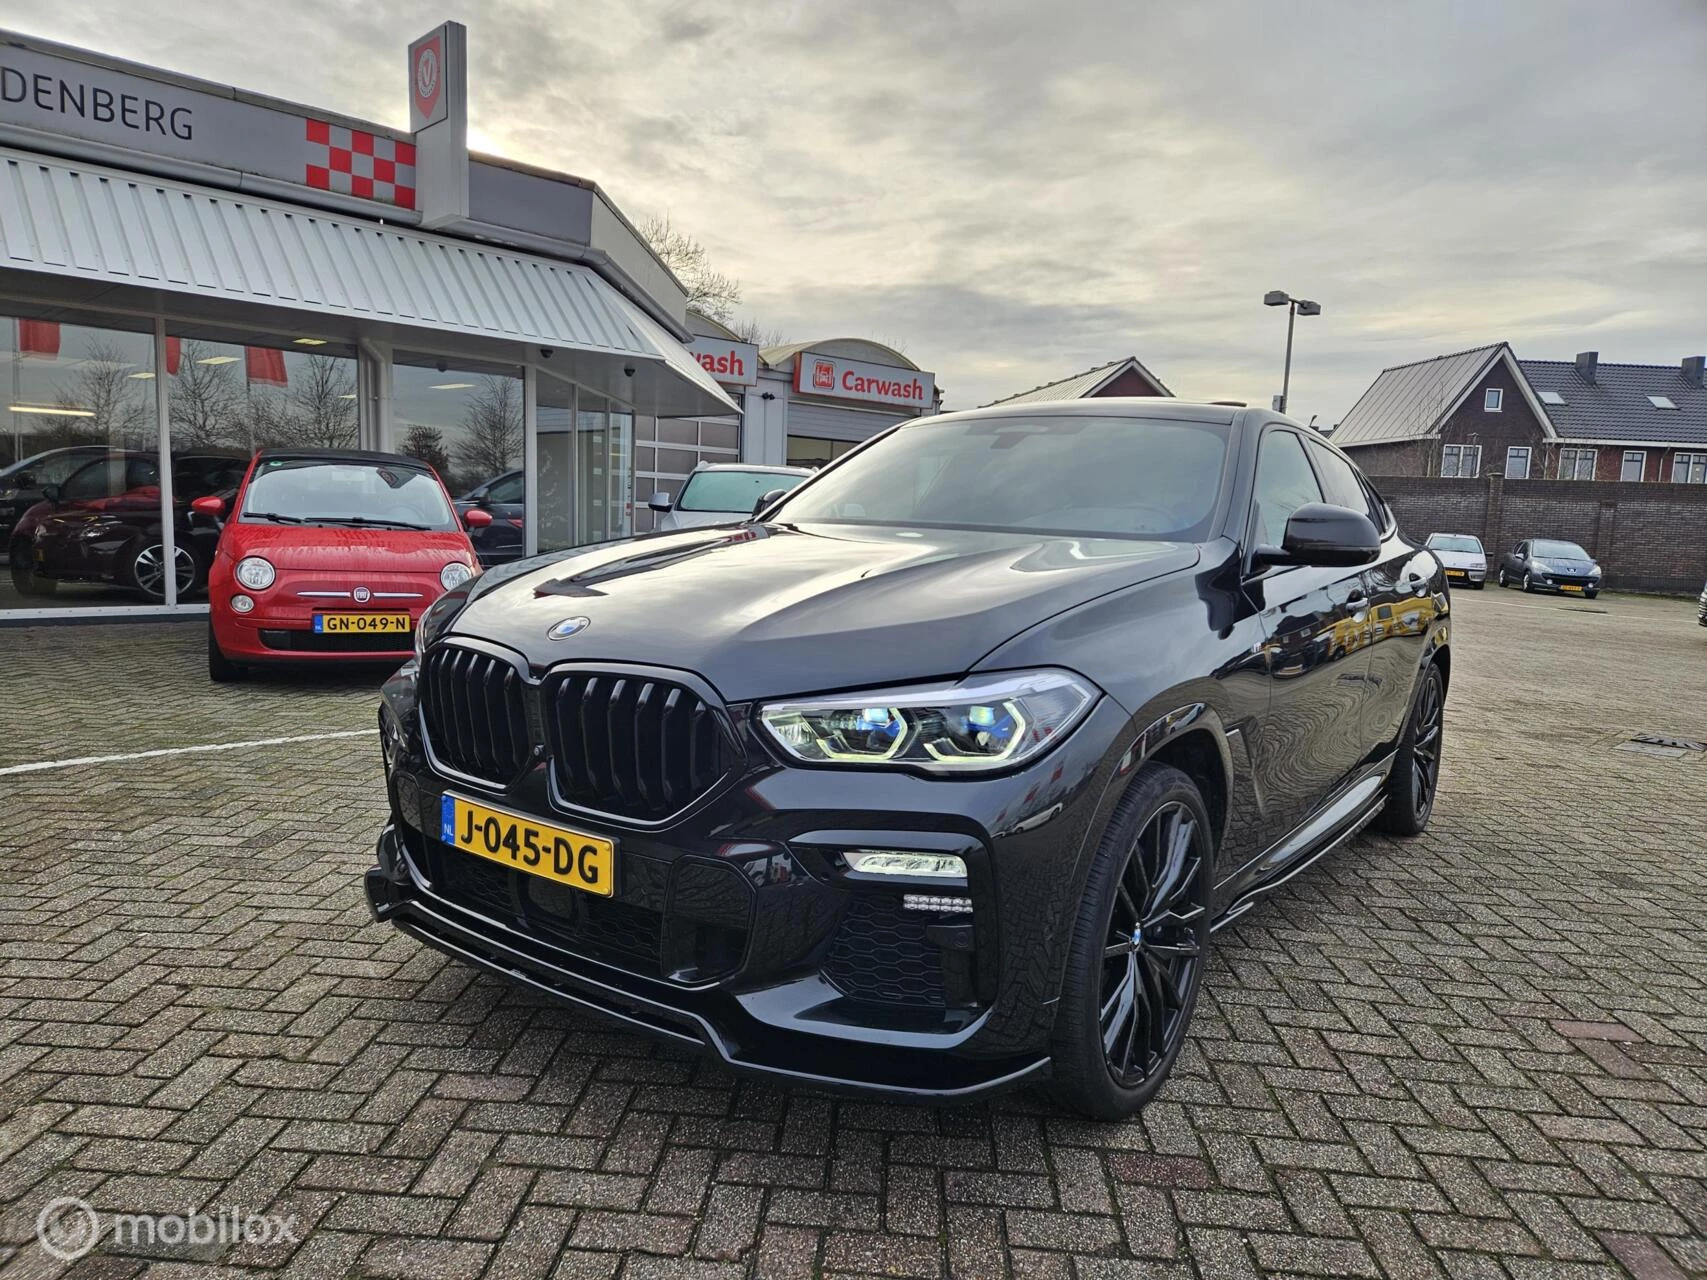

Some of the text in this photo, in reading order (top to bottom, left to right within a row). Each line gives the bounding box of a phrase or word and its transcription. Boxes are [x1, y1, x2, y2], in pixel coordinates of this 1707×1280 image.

[0, 66, 193, 141] DENBERG
[841, 370, 923, 400] Carwash
[327, 617, 406, 631] GN-049-N
[443, 810, 599, 884] NL J-045-DG
